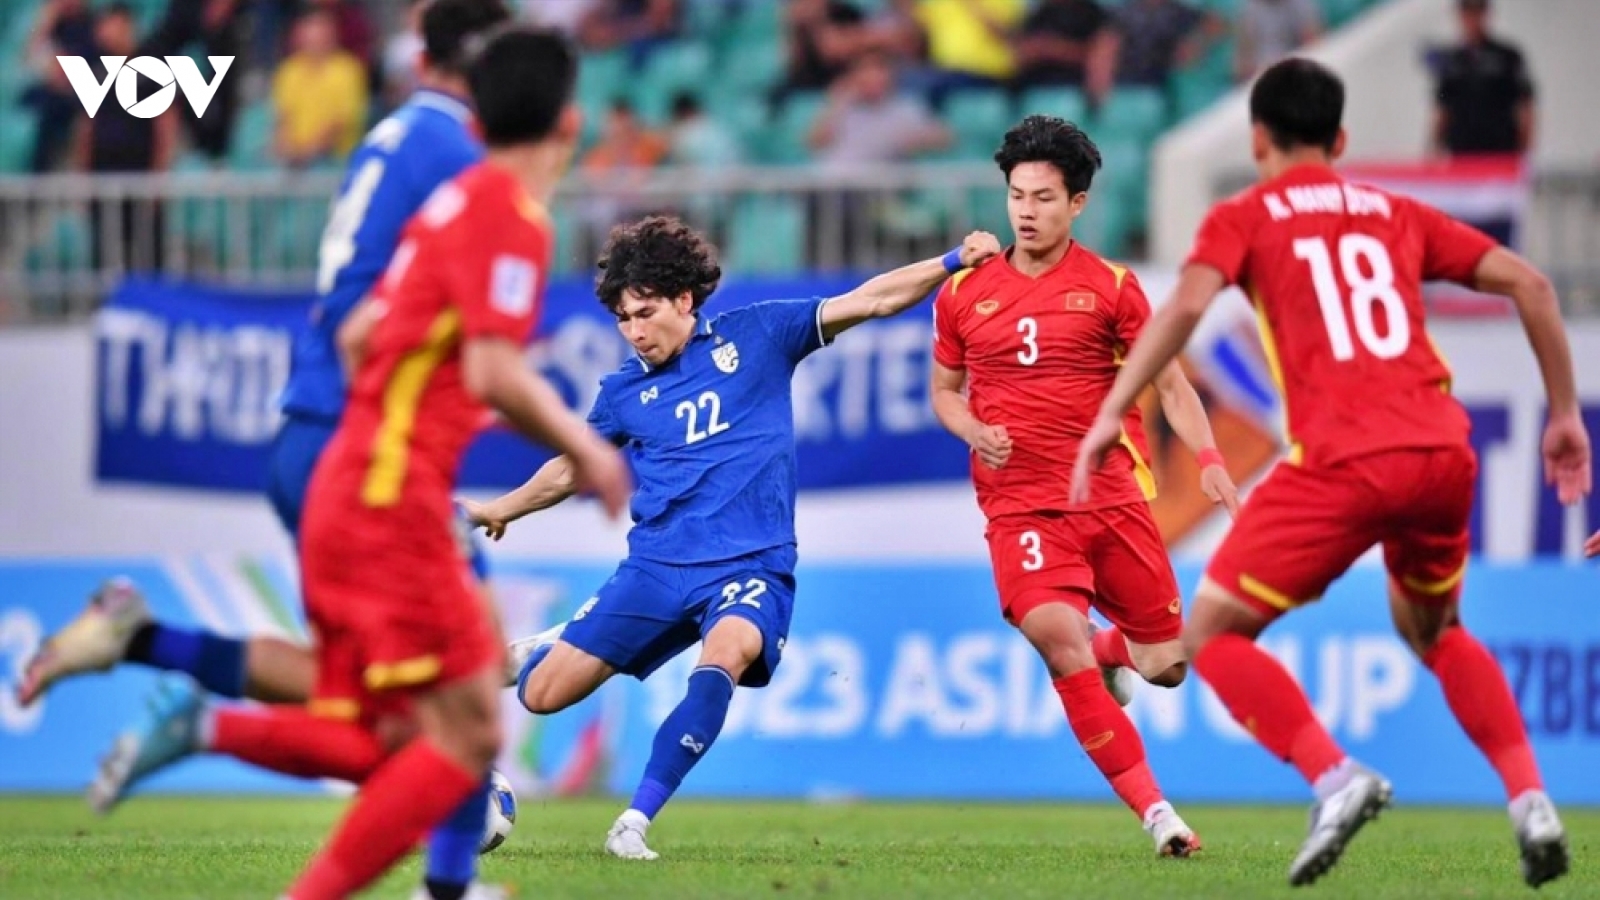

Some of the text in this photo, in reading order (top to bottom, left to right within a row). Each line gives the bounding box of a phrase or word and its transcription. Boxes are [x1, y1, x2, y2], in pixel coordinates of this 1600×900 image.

[1293, 233, 1411, 361] 18
[1016, 317, 1038, 366] 3
[675, 391, 730, 445] 22
[1019, 530, 1043, 570] 3
[719, 578, 767, 611] 22
